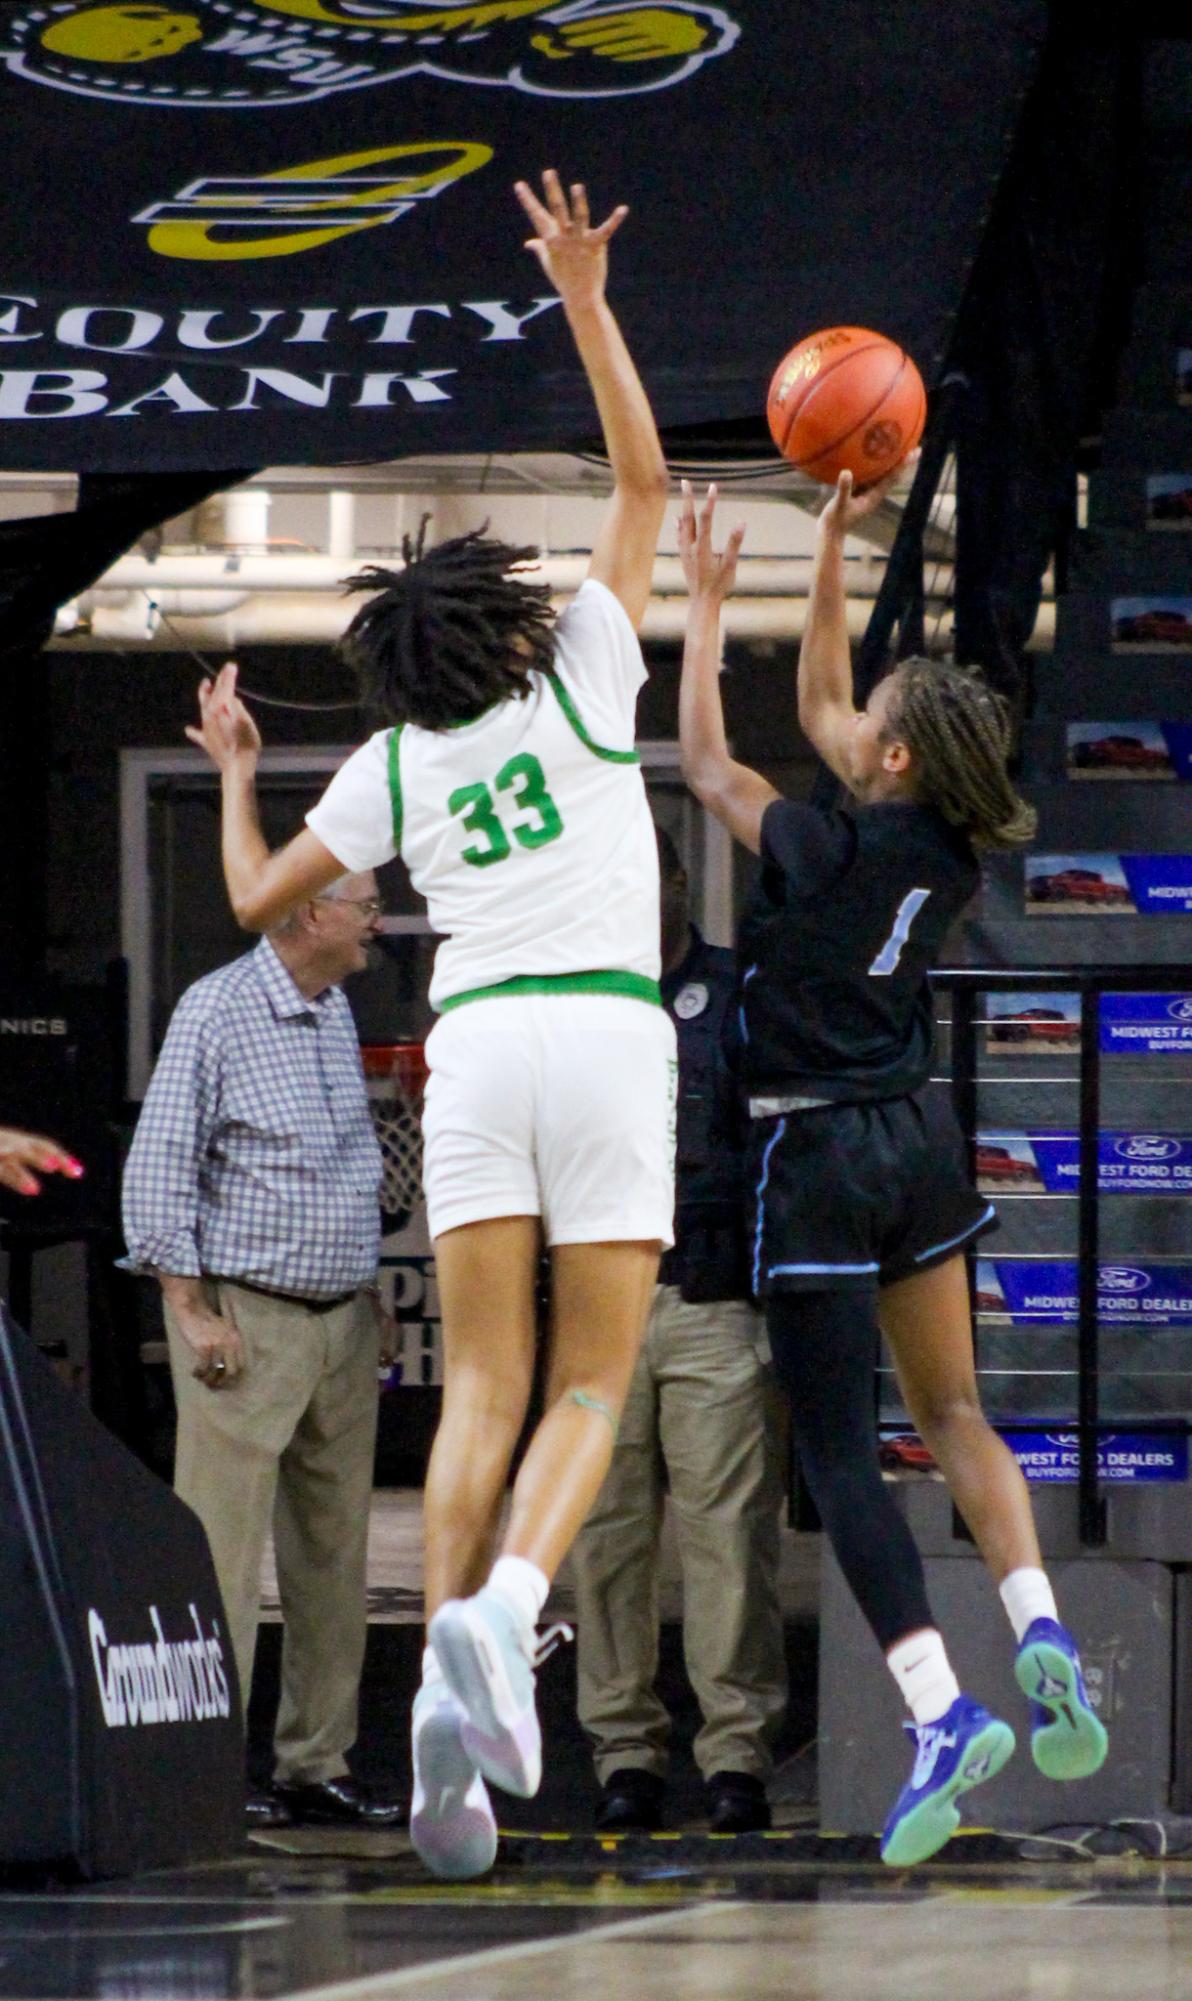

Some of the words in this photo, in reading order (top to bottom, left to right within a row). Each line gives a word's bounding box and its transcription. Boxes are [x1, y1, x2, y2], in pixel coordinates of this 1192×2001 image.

[203, 27, 374, 85] WSU
[0, 367, 459, 420] BANK
[447, 752, 565, 868] 33
[867, 887, 932, 976] 1
[1110, 1026, 1179, 1038] MIDWEST
[1181, 1027, 1192, 1038] F
[1126, 1139, 1169, 1156] Ford
[1056, 1164, 1126, 1176] MIDEST
[1128, 1165, 1170, 1177] FORD
[1173, 1166, 1192, 1177] DE
[1024, 1296, 1080, 1309] MIDWE
[1097, 1298, 1138, 1310] FORD
[1016, 1453, 1058, 1465] WEST
[1107, 1453, 1175, 1466] DEALERS
[88, 1602, 231, 1728] Groundworks
